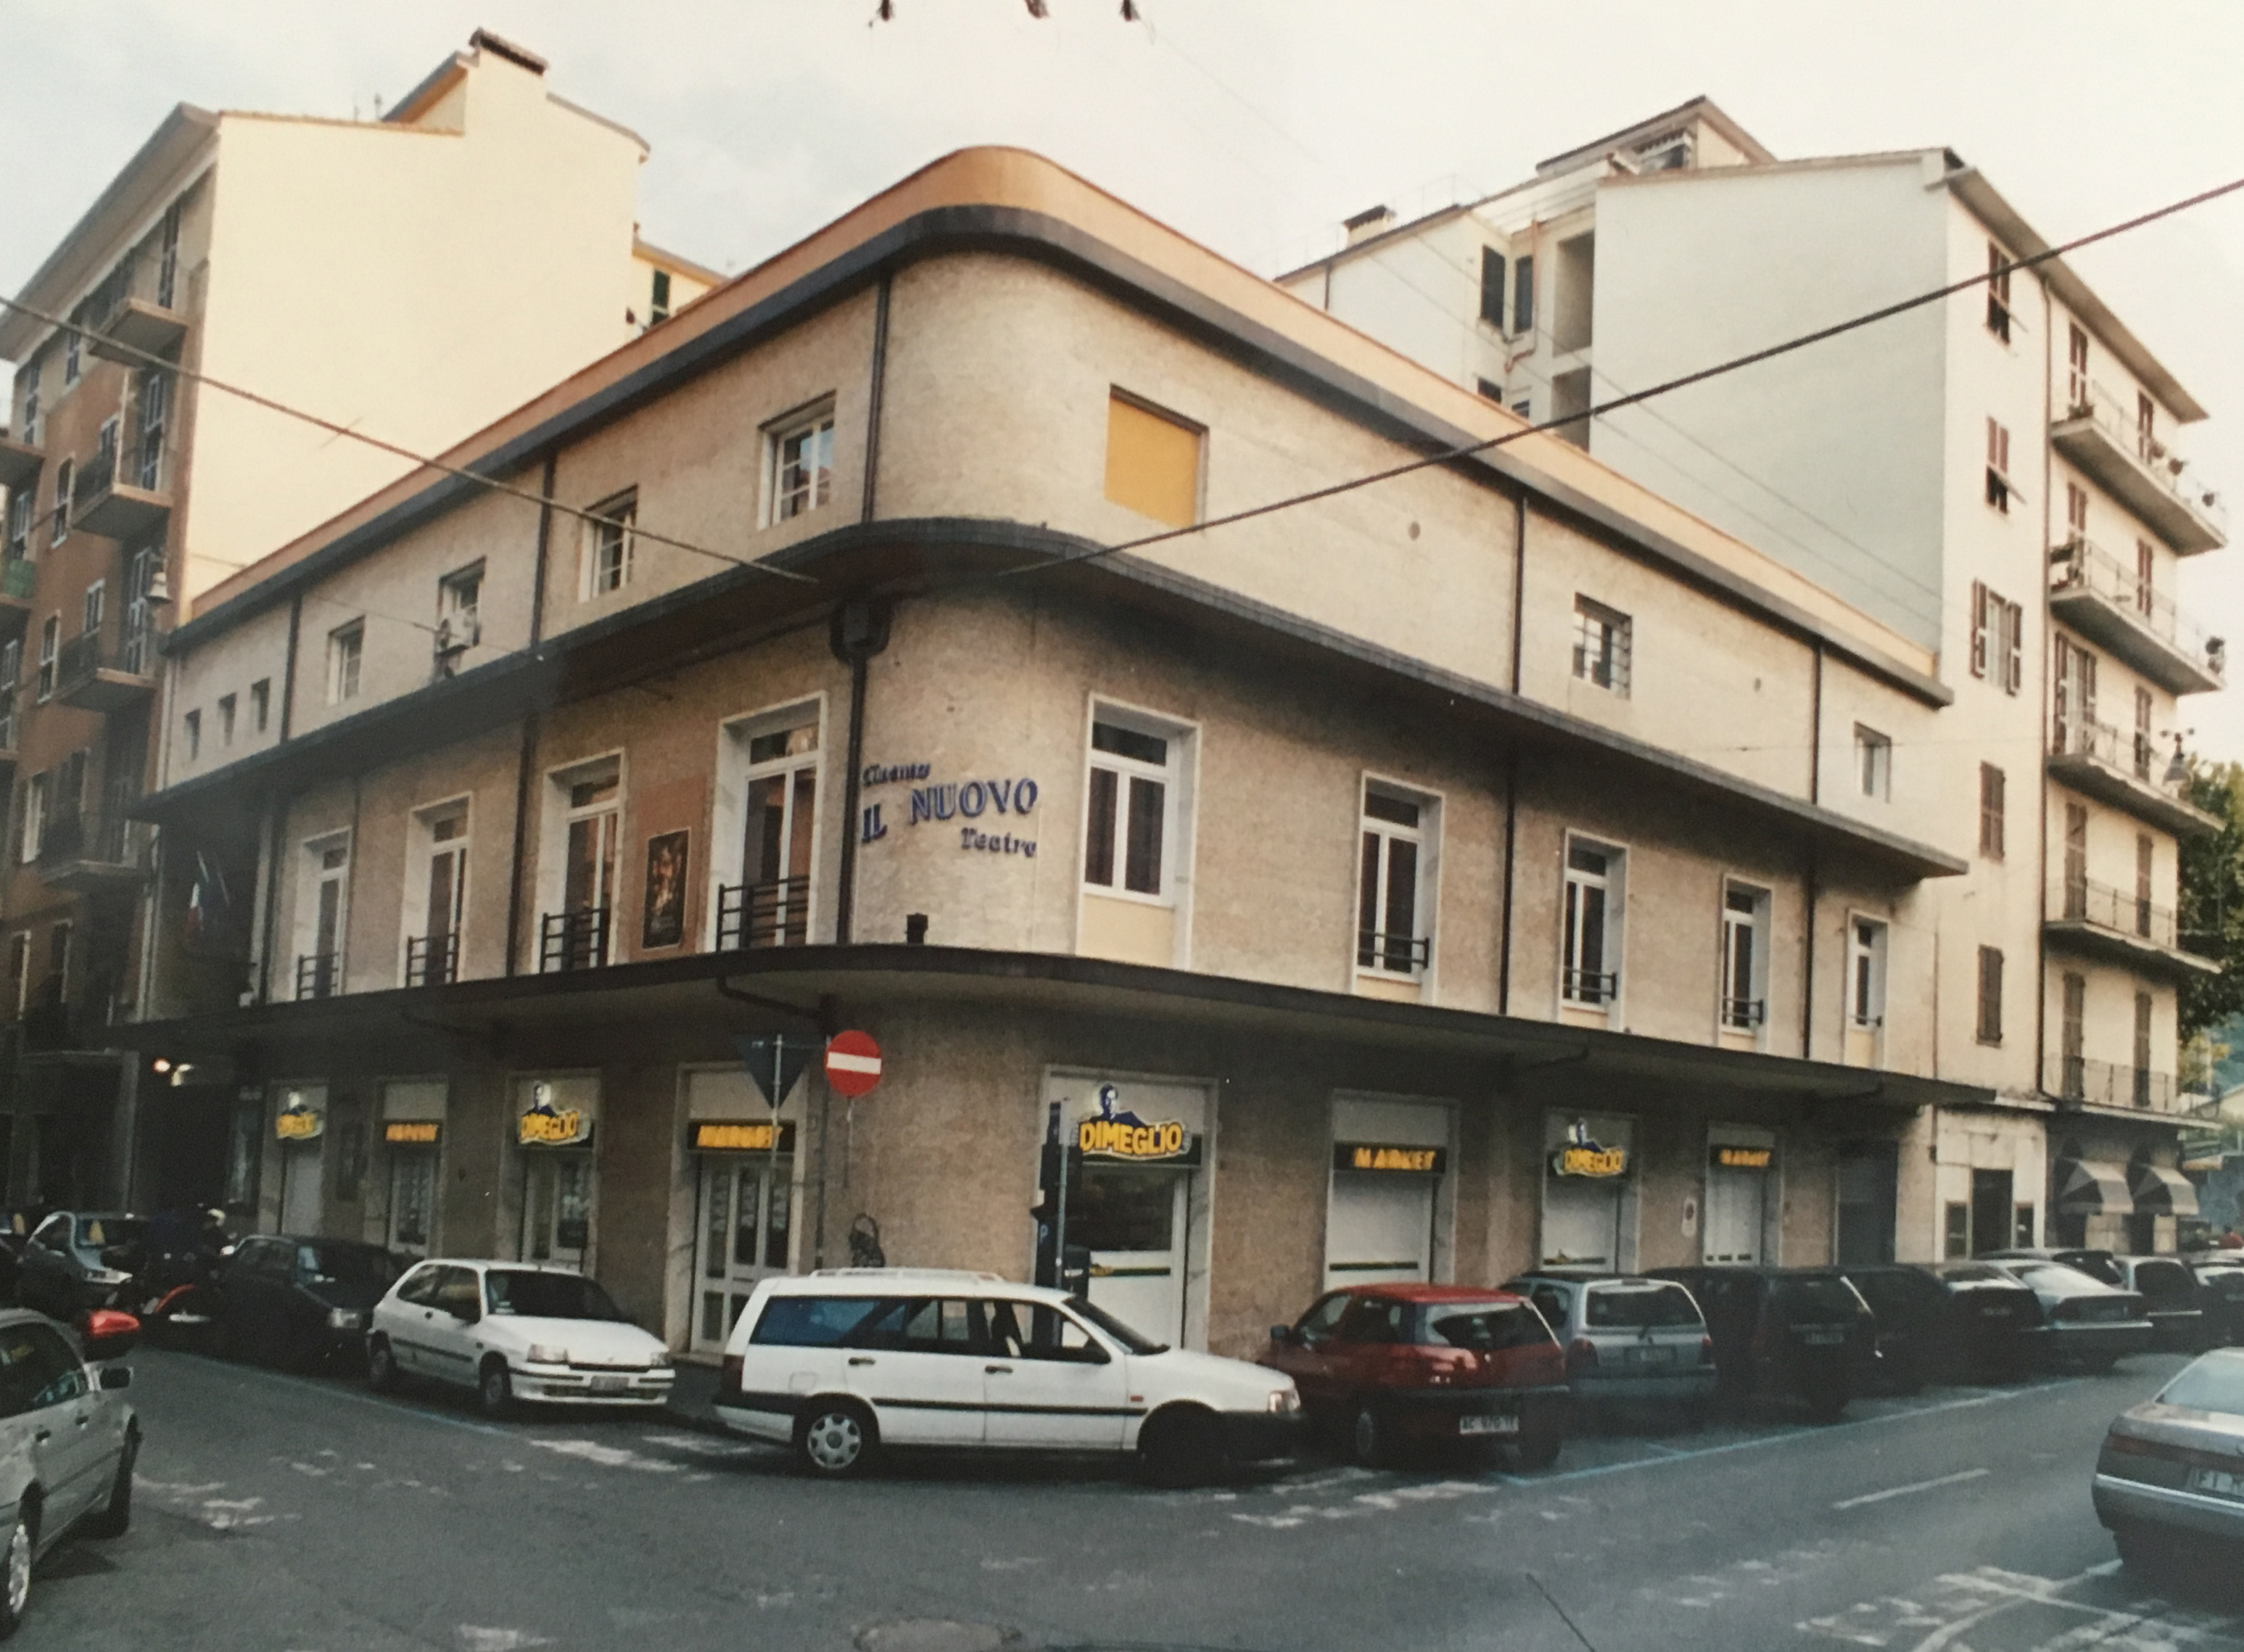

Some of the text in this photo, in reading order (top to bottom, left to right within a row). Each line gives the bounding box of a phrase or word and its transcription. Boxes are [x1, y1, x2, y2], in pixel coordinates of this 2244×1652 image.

[862, 777, 1039, 843] IL NUOVO
[960, 827, 1037, 858] Teatro
[1079, 1120, 1183, 1156] DIMEGLIO
[1355, 1147, 1437, 1170] MARKET
